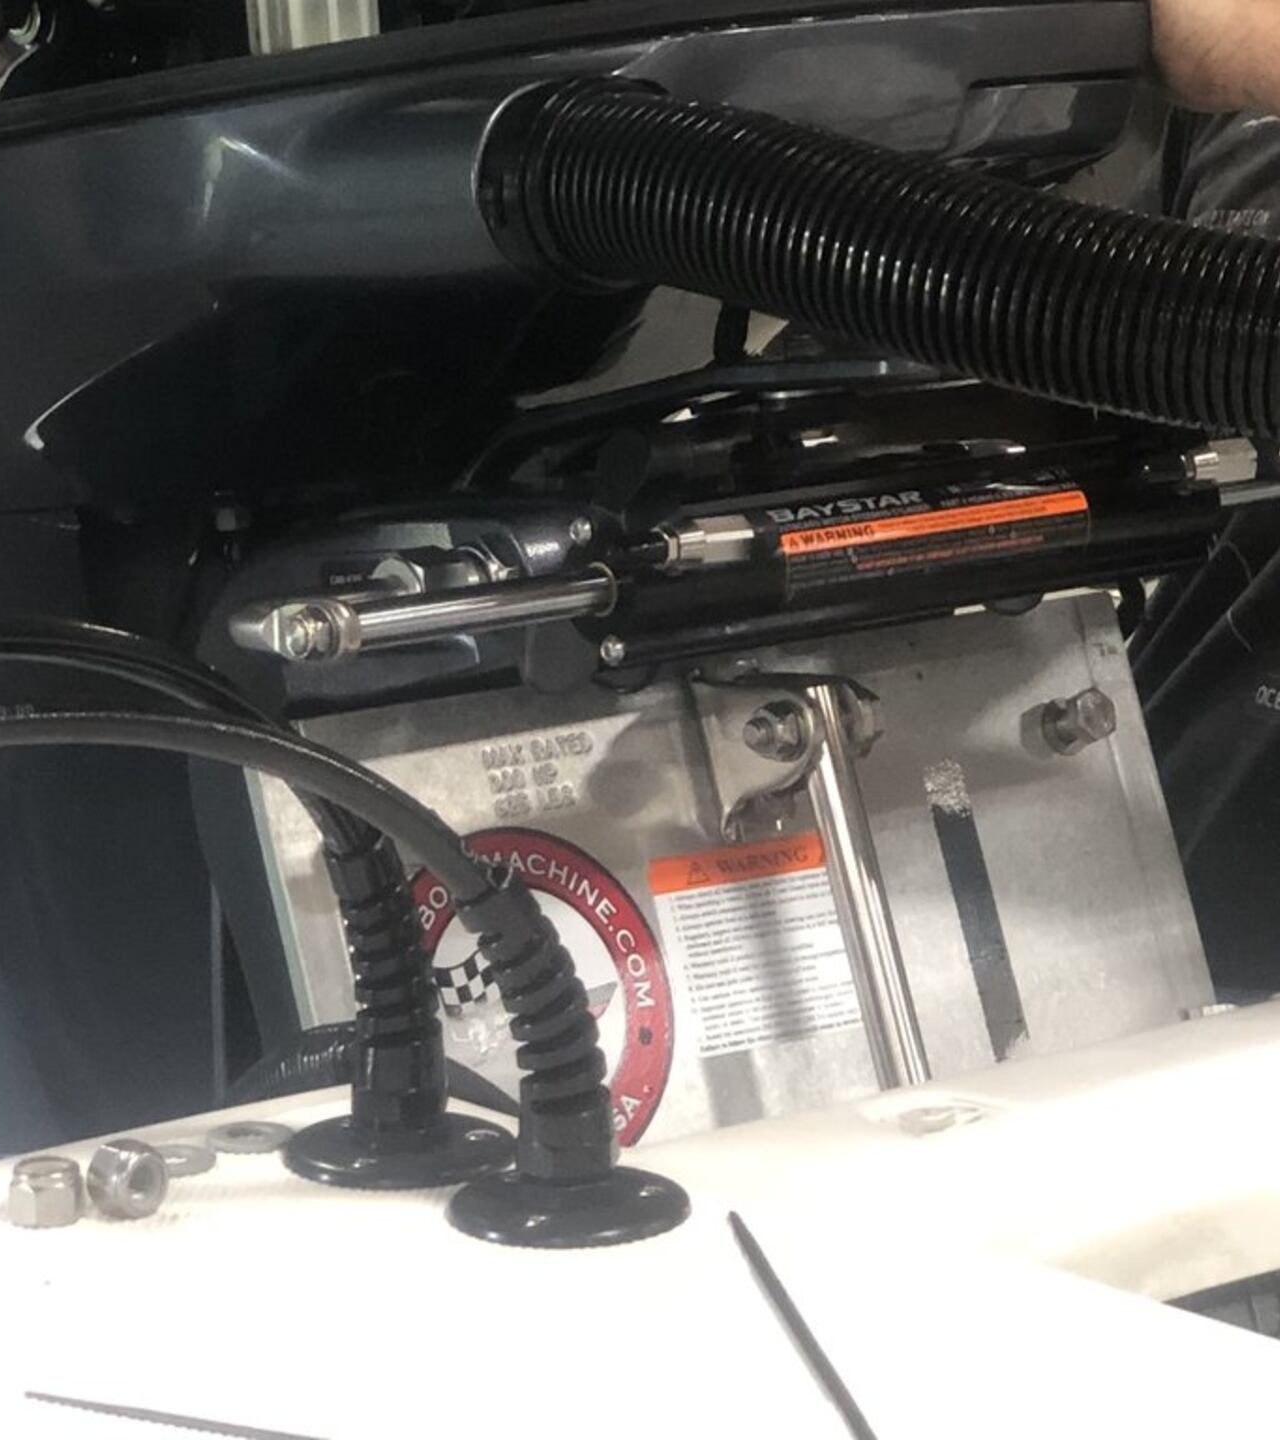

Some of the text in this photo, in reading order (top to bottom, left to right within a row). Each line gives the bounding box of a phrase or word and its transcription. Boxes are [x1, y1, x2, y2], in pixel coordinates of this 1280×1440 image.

[767, 490, 923, 523] BAYSTAR
[800, 525, 875, 546] WARNING
[716, 845, 809, 873] WARNING
[419, 849, 655, 1009] BOMACHINE.COM
[611, 1094, 642, 1133] SA
